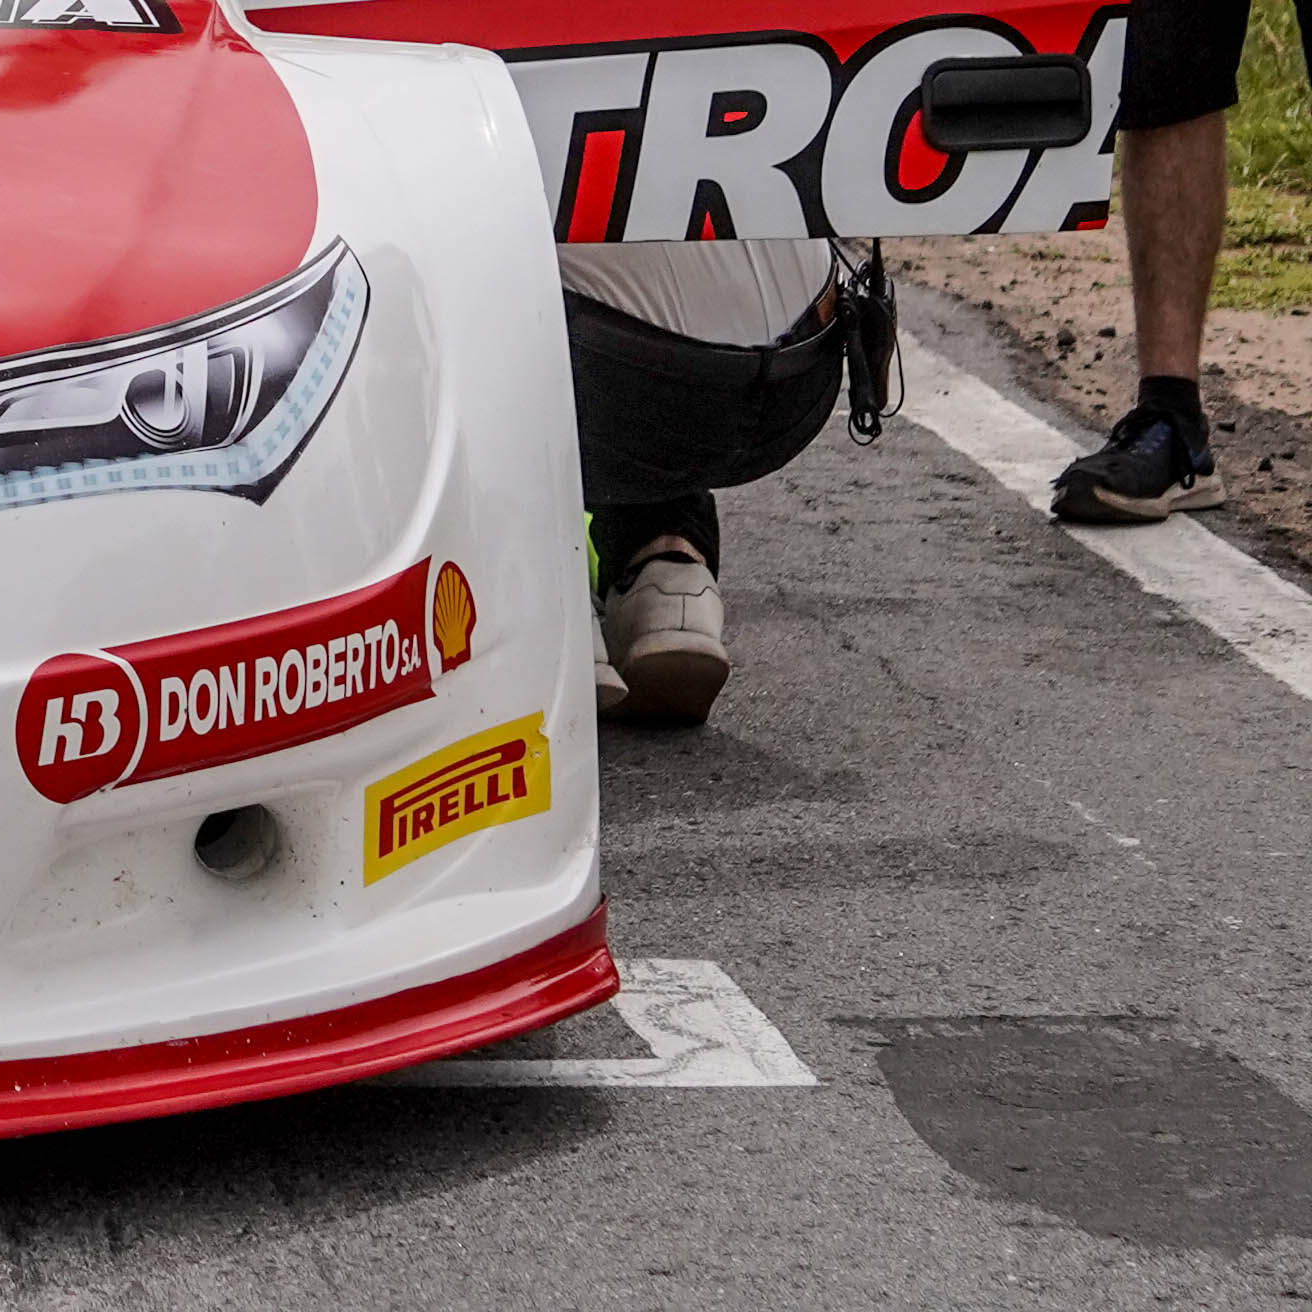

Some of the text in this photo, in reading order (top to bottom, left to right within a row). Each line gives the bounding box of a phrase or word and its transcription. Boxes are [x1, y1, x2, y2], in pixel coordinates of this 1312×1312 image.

[159, 657, 246, 743] DON
[253, 618, 400, 723] ROBERTO
[378, 738, 528, 859] PIRELLI
